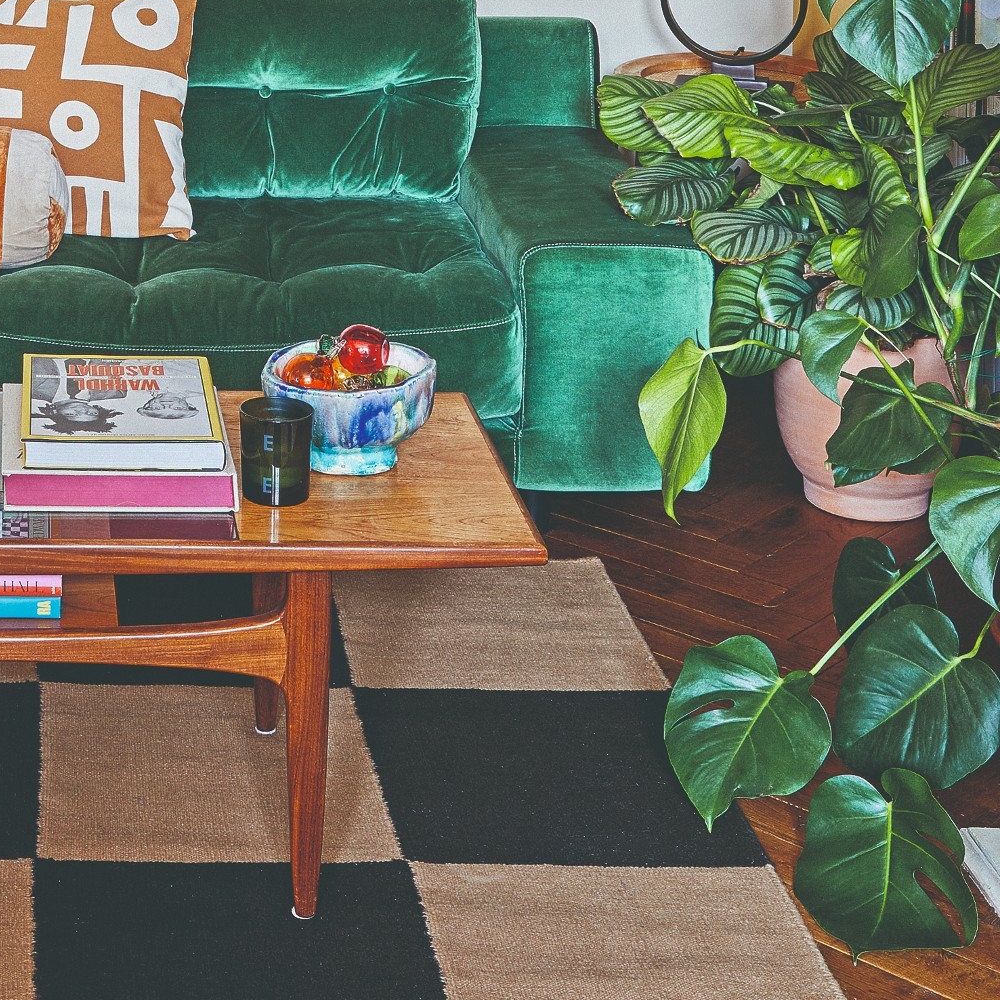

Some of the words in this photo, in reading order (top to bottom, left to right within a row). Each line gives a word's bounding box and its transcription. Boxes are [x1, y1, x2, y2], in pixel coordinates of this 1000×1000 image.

[66, 364, 165, 377] BASQUIAT
[77, 379, 160, 391] WARHOL
[263, 434, 274, 452] E
[262, 476, 272, 494] E
[3, 580, 48, 593] HALL
